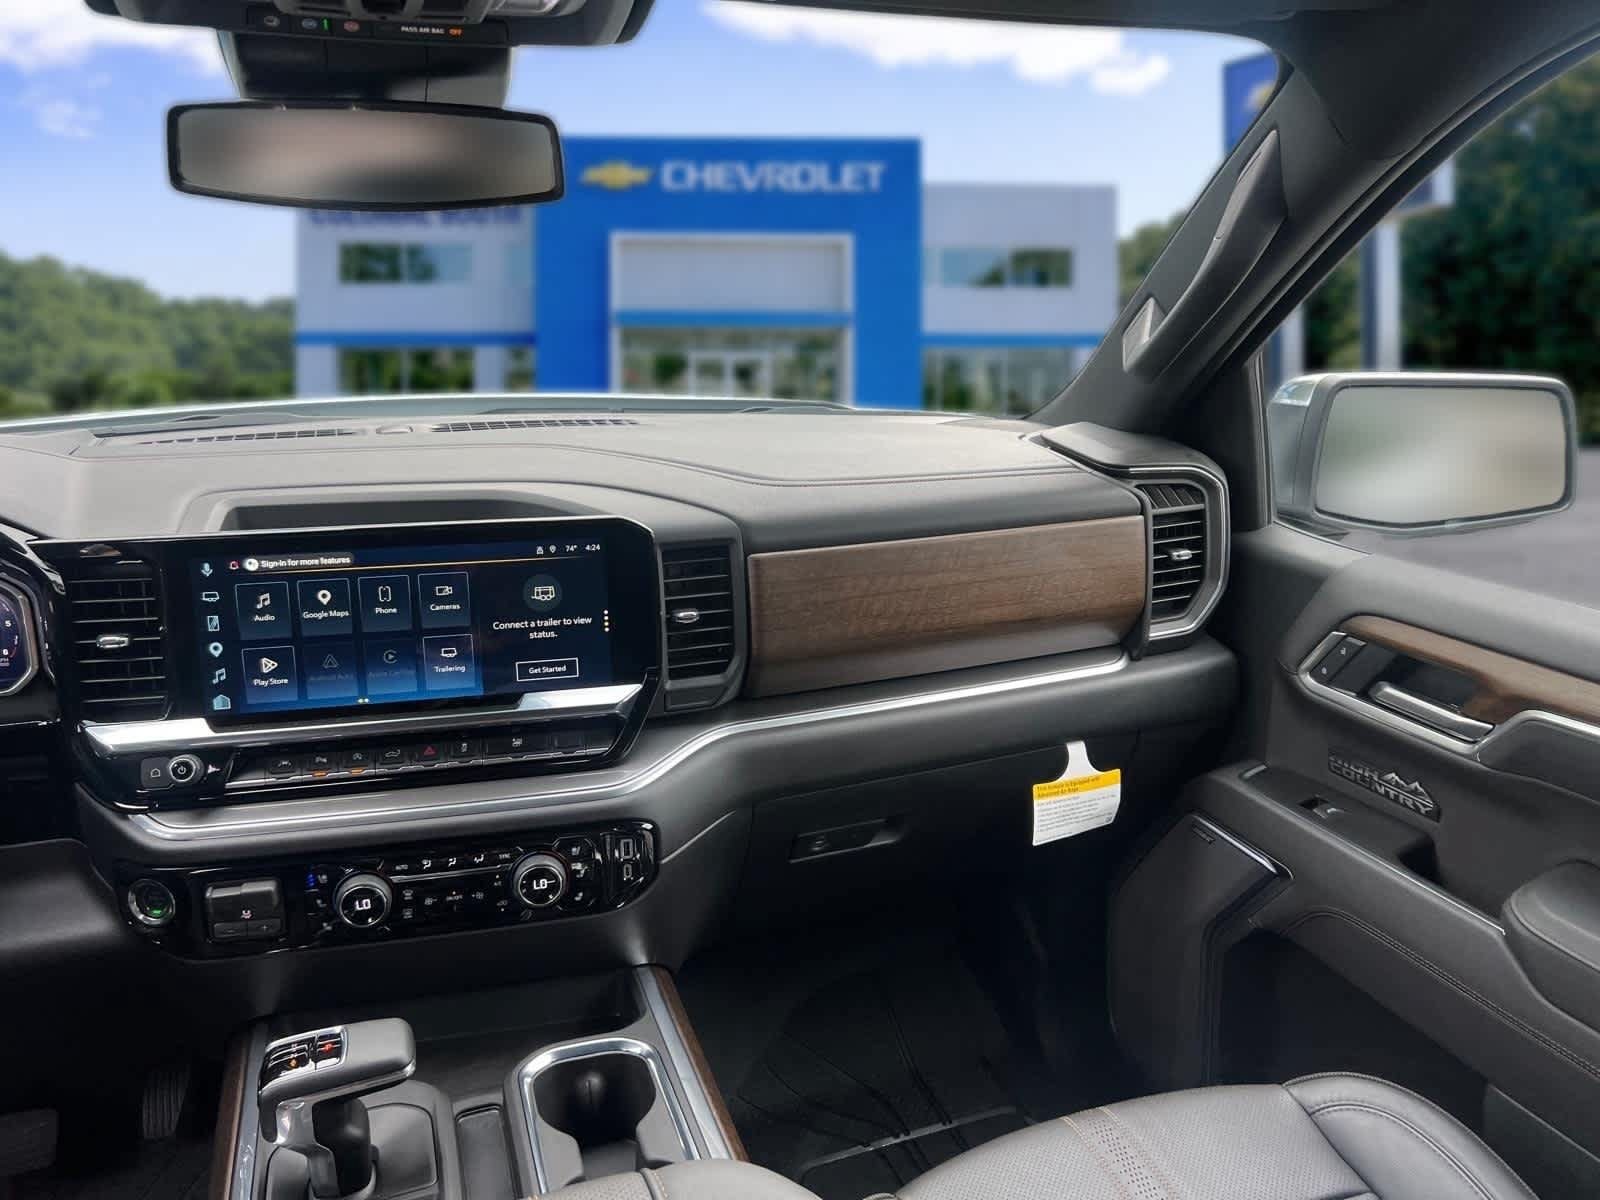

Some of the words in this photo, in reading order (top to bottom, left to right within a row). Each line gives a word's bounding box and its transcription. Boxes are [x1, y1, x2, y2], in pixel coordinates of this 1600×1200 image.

[660, 160, 886, 193] CHEVROLET
[288, 558, 298, 567] for
[320, 557, 351, 565] features
[429, 603, 461, 611] Cameras
[254, 614, 276, 622] Audio
[302, 611, 328, 620] Google
[329, 610, 350, 618] Maps
[492, 620, 529, 630] Connect
[537, 617, 562, 627] trailer
[563, 617, 572, 626] to
[573, 615, 593, 625] view
[529, 629, 558, 640] status.
[433, 665, 466, 673] Trailering
[528, 666, 541, 675] Get
[542, 664, 567, 674] Started
[253, 678, 269, 687] Play
[270, 677, 289, 685] Store
[1329, 762, 1433, 815] COUNTRY
